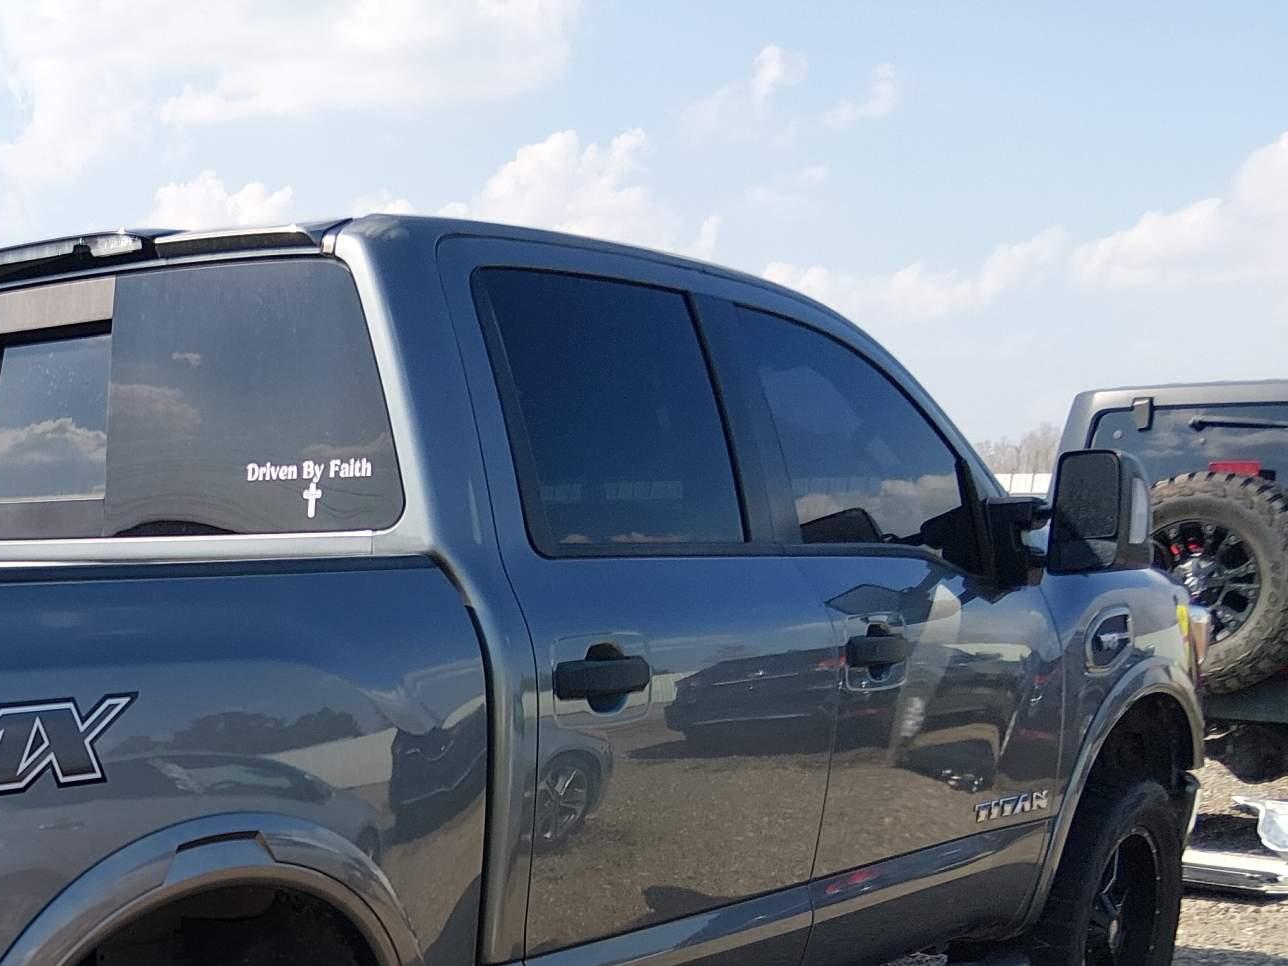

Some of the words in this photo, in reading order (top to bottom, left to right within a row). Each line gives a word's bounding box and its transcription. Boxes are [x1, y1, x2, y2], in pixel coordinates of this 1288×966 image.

[247, 462, 298, 482] Driven
[302, 460, 325, 484] By
[329, 457, 372, 479] Faith
[975, 790, 1049, 823] TITAN
